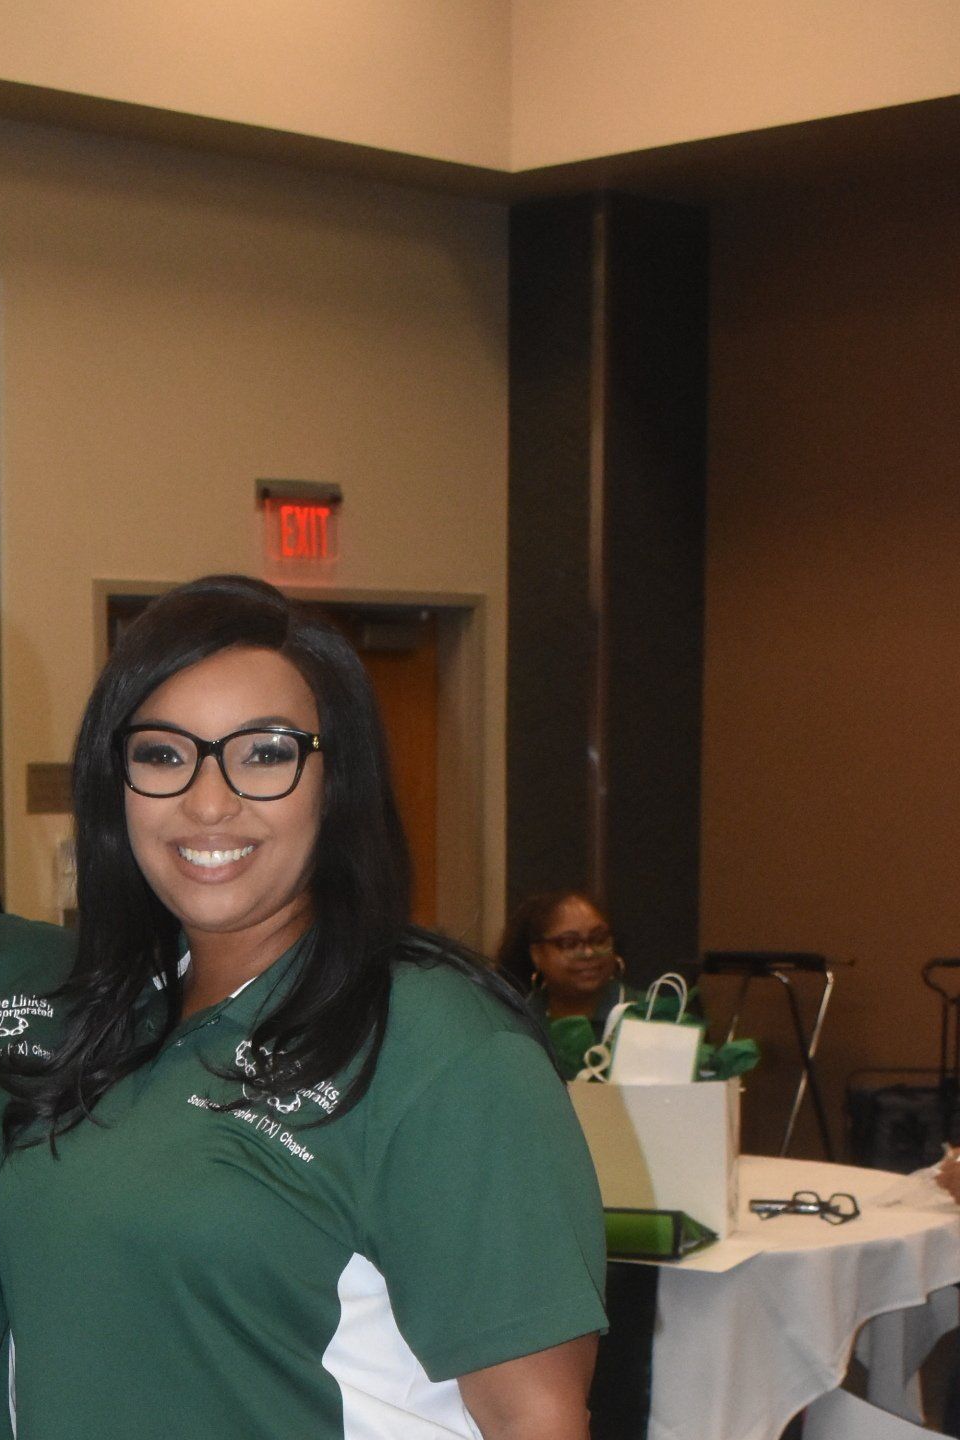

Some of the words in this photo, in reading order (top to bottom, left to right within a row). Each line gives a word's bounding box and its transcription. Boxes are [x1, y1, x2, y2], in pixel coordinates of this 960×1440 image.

[280, 505, 330, 559] EXIT
[255, 1115, 281, 1139] (TX)
[280, 1132, 315, 1163] Chapter
